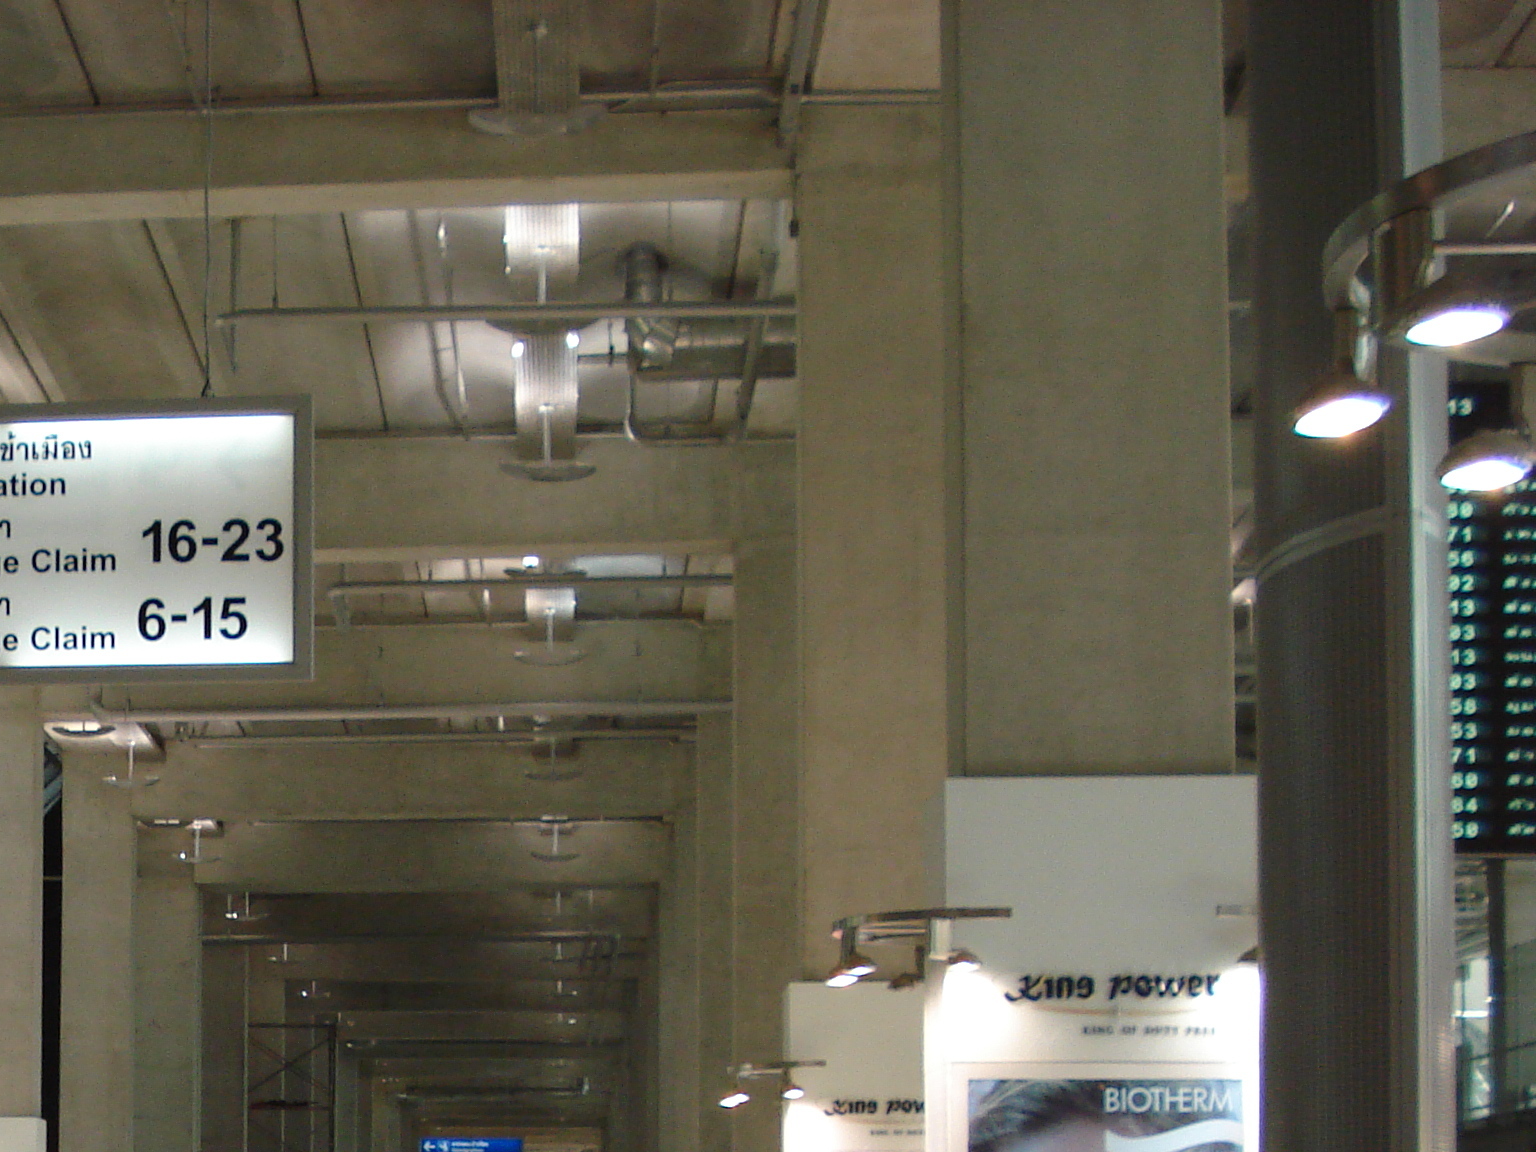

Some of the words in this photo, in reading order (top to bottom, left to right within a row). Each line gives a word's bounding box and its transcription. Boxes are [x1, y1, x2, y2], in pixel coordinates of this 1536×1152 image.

[31, 548, 117, 573] Claim
[142, 517, 285, 563] 16-23
[30, 625, 116, 651] Claim
[137, 596, 248, 642] 6-15
[1003, 973, 1096, 1003] King
[1103, 1086, 1234, 1114] BIOTHERM
